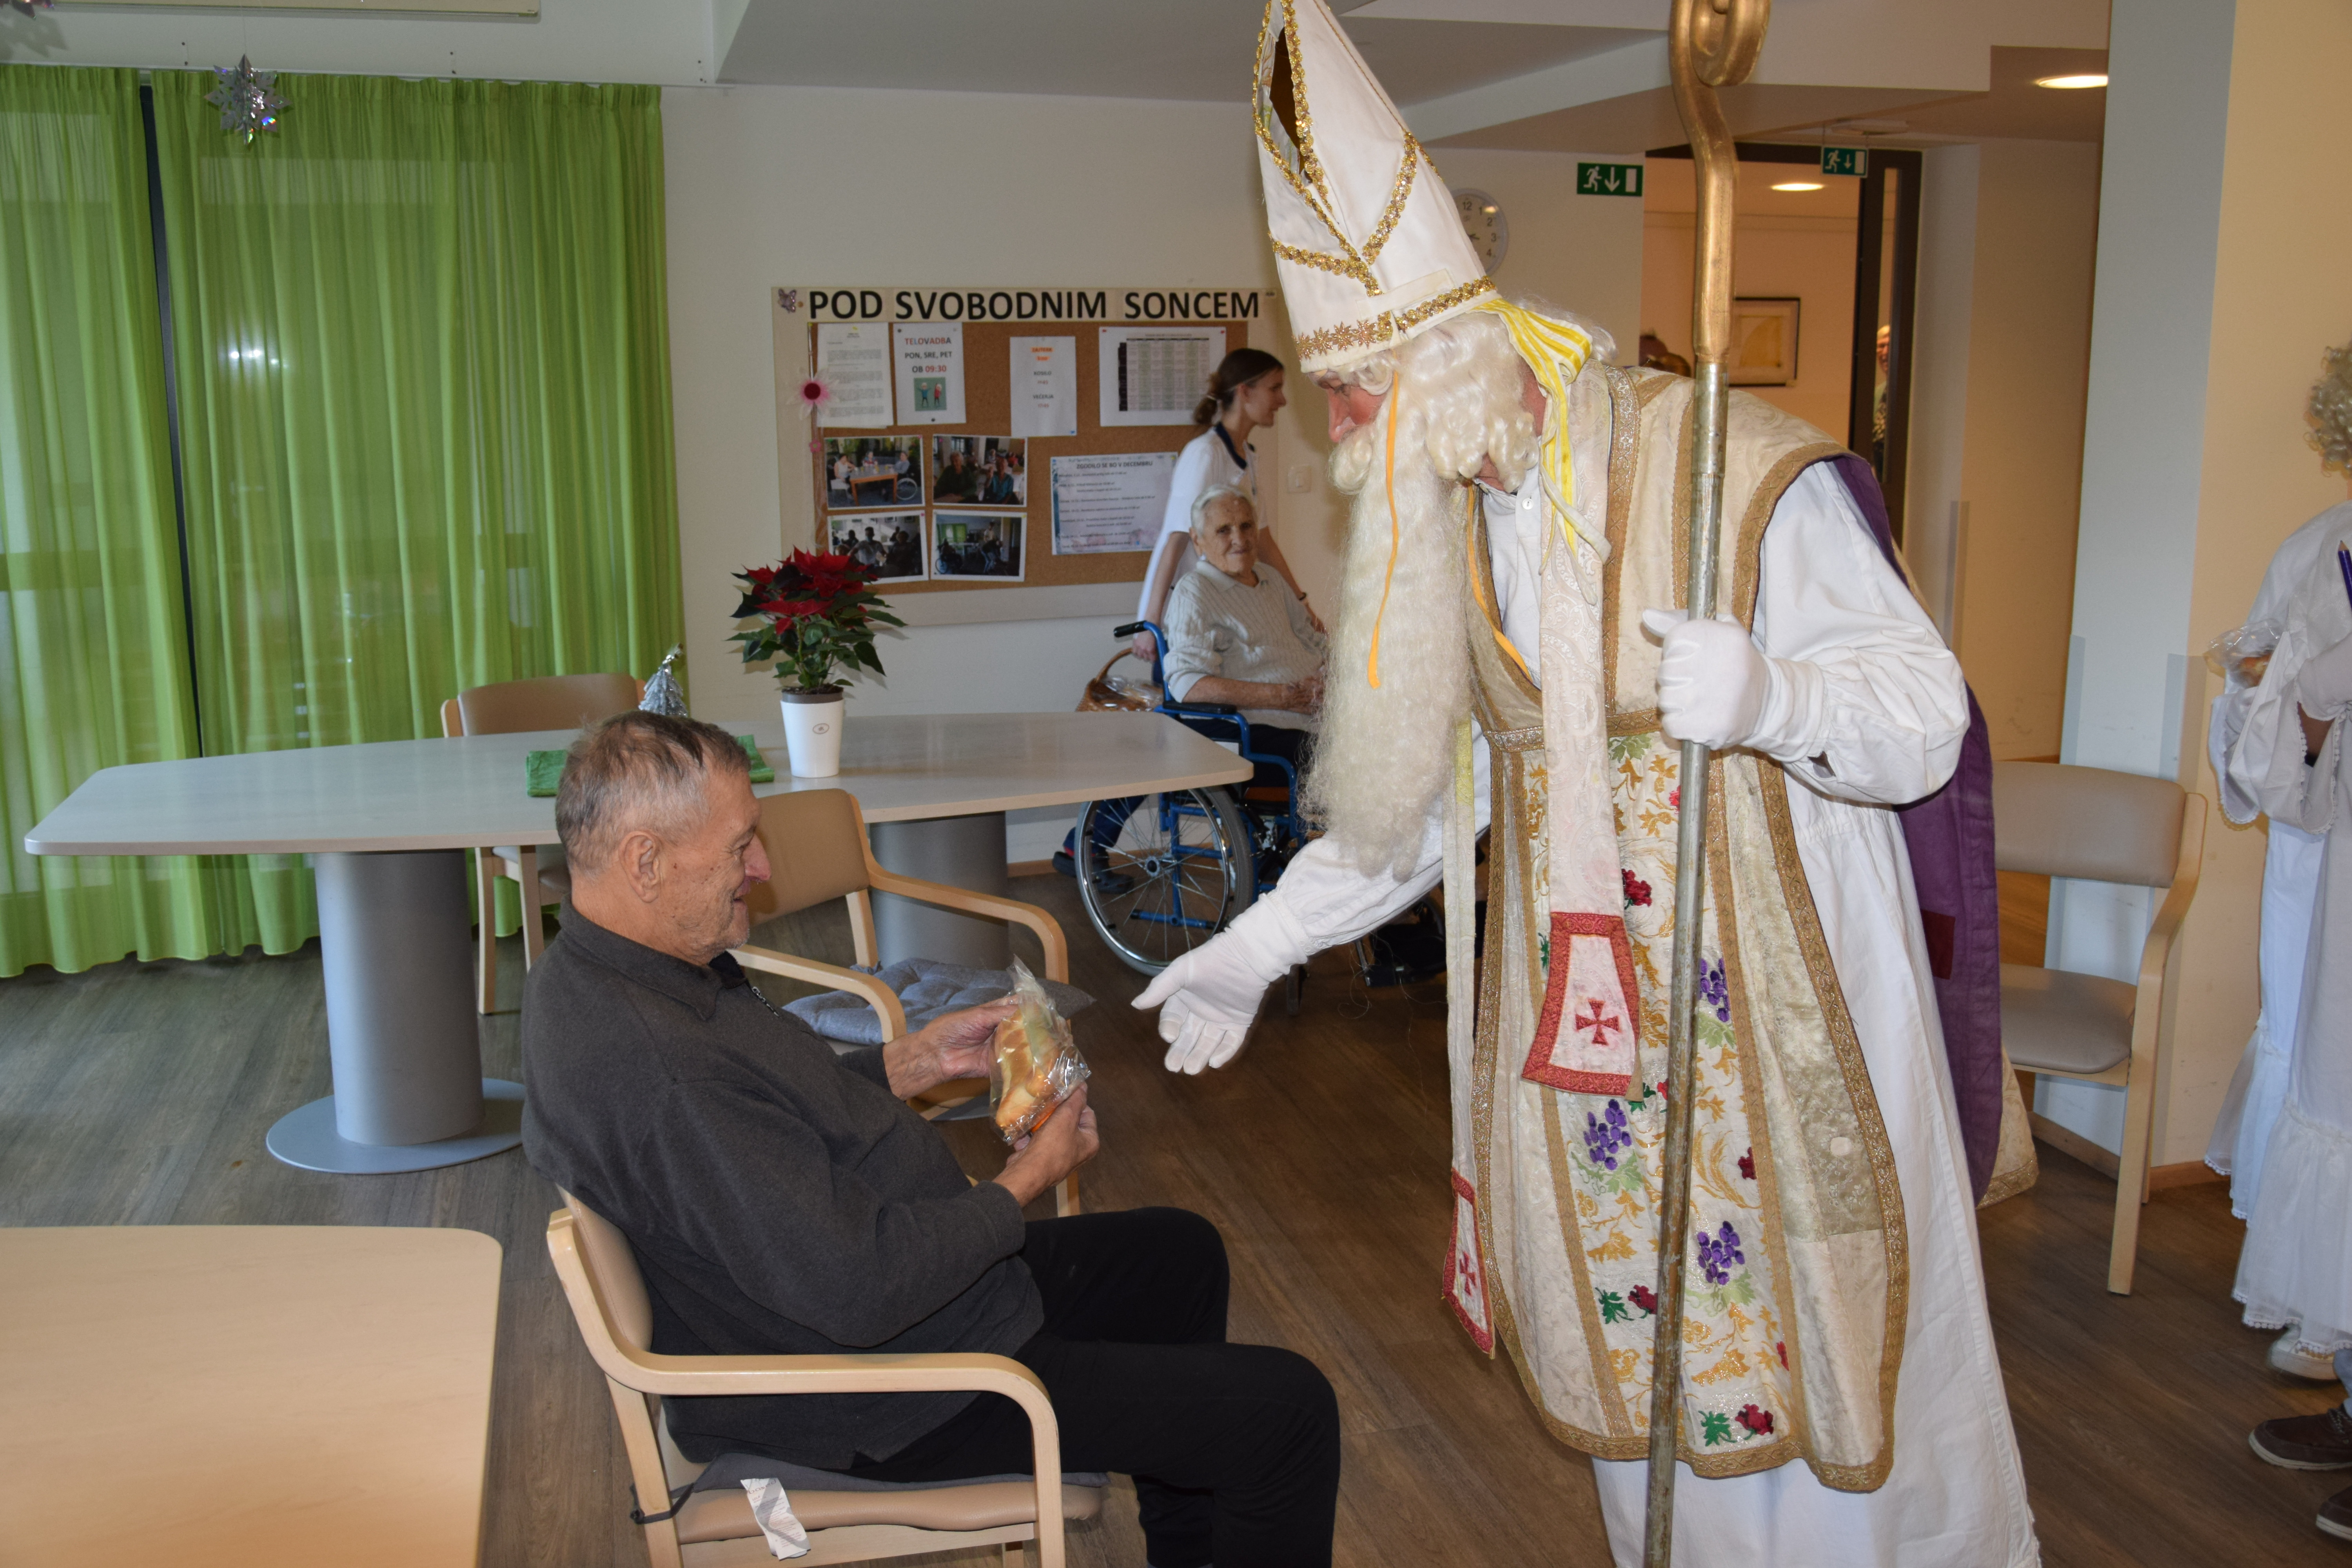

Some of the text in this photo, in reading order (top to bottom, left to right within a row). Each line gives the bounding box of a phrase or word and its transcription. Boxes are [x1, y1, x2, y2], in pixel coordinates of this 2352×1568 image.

[1463, 201, 1472, 211] 12
[1479, 206, 1483, 215] 1
[1487, 217, 1492, 227] 2
[1491, 232, 1497, 242] 3
[1486, 249, 1492, 257] 4
[810, 290, 1258, 320] POD SVOBODNIM SONCEM
